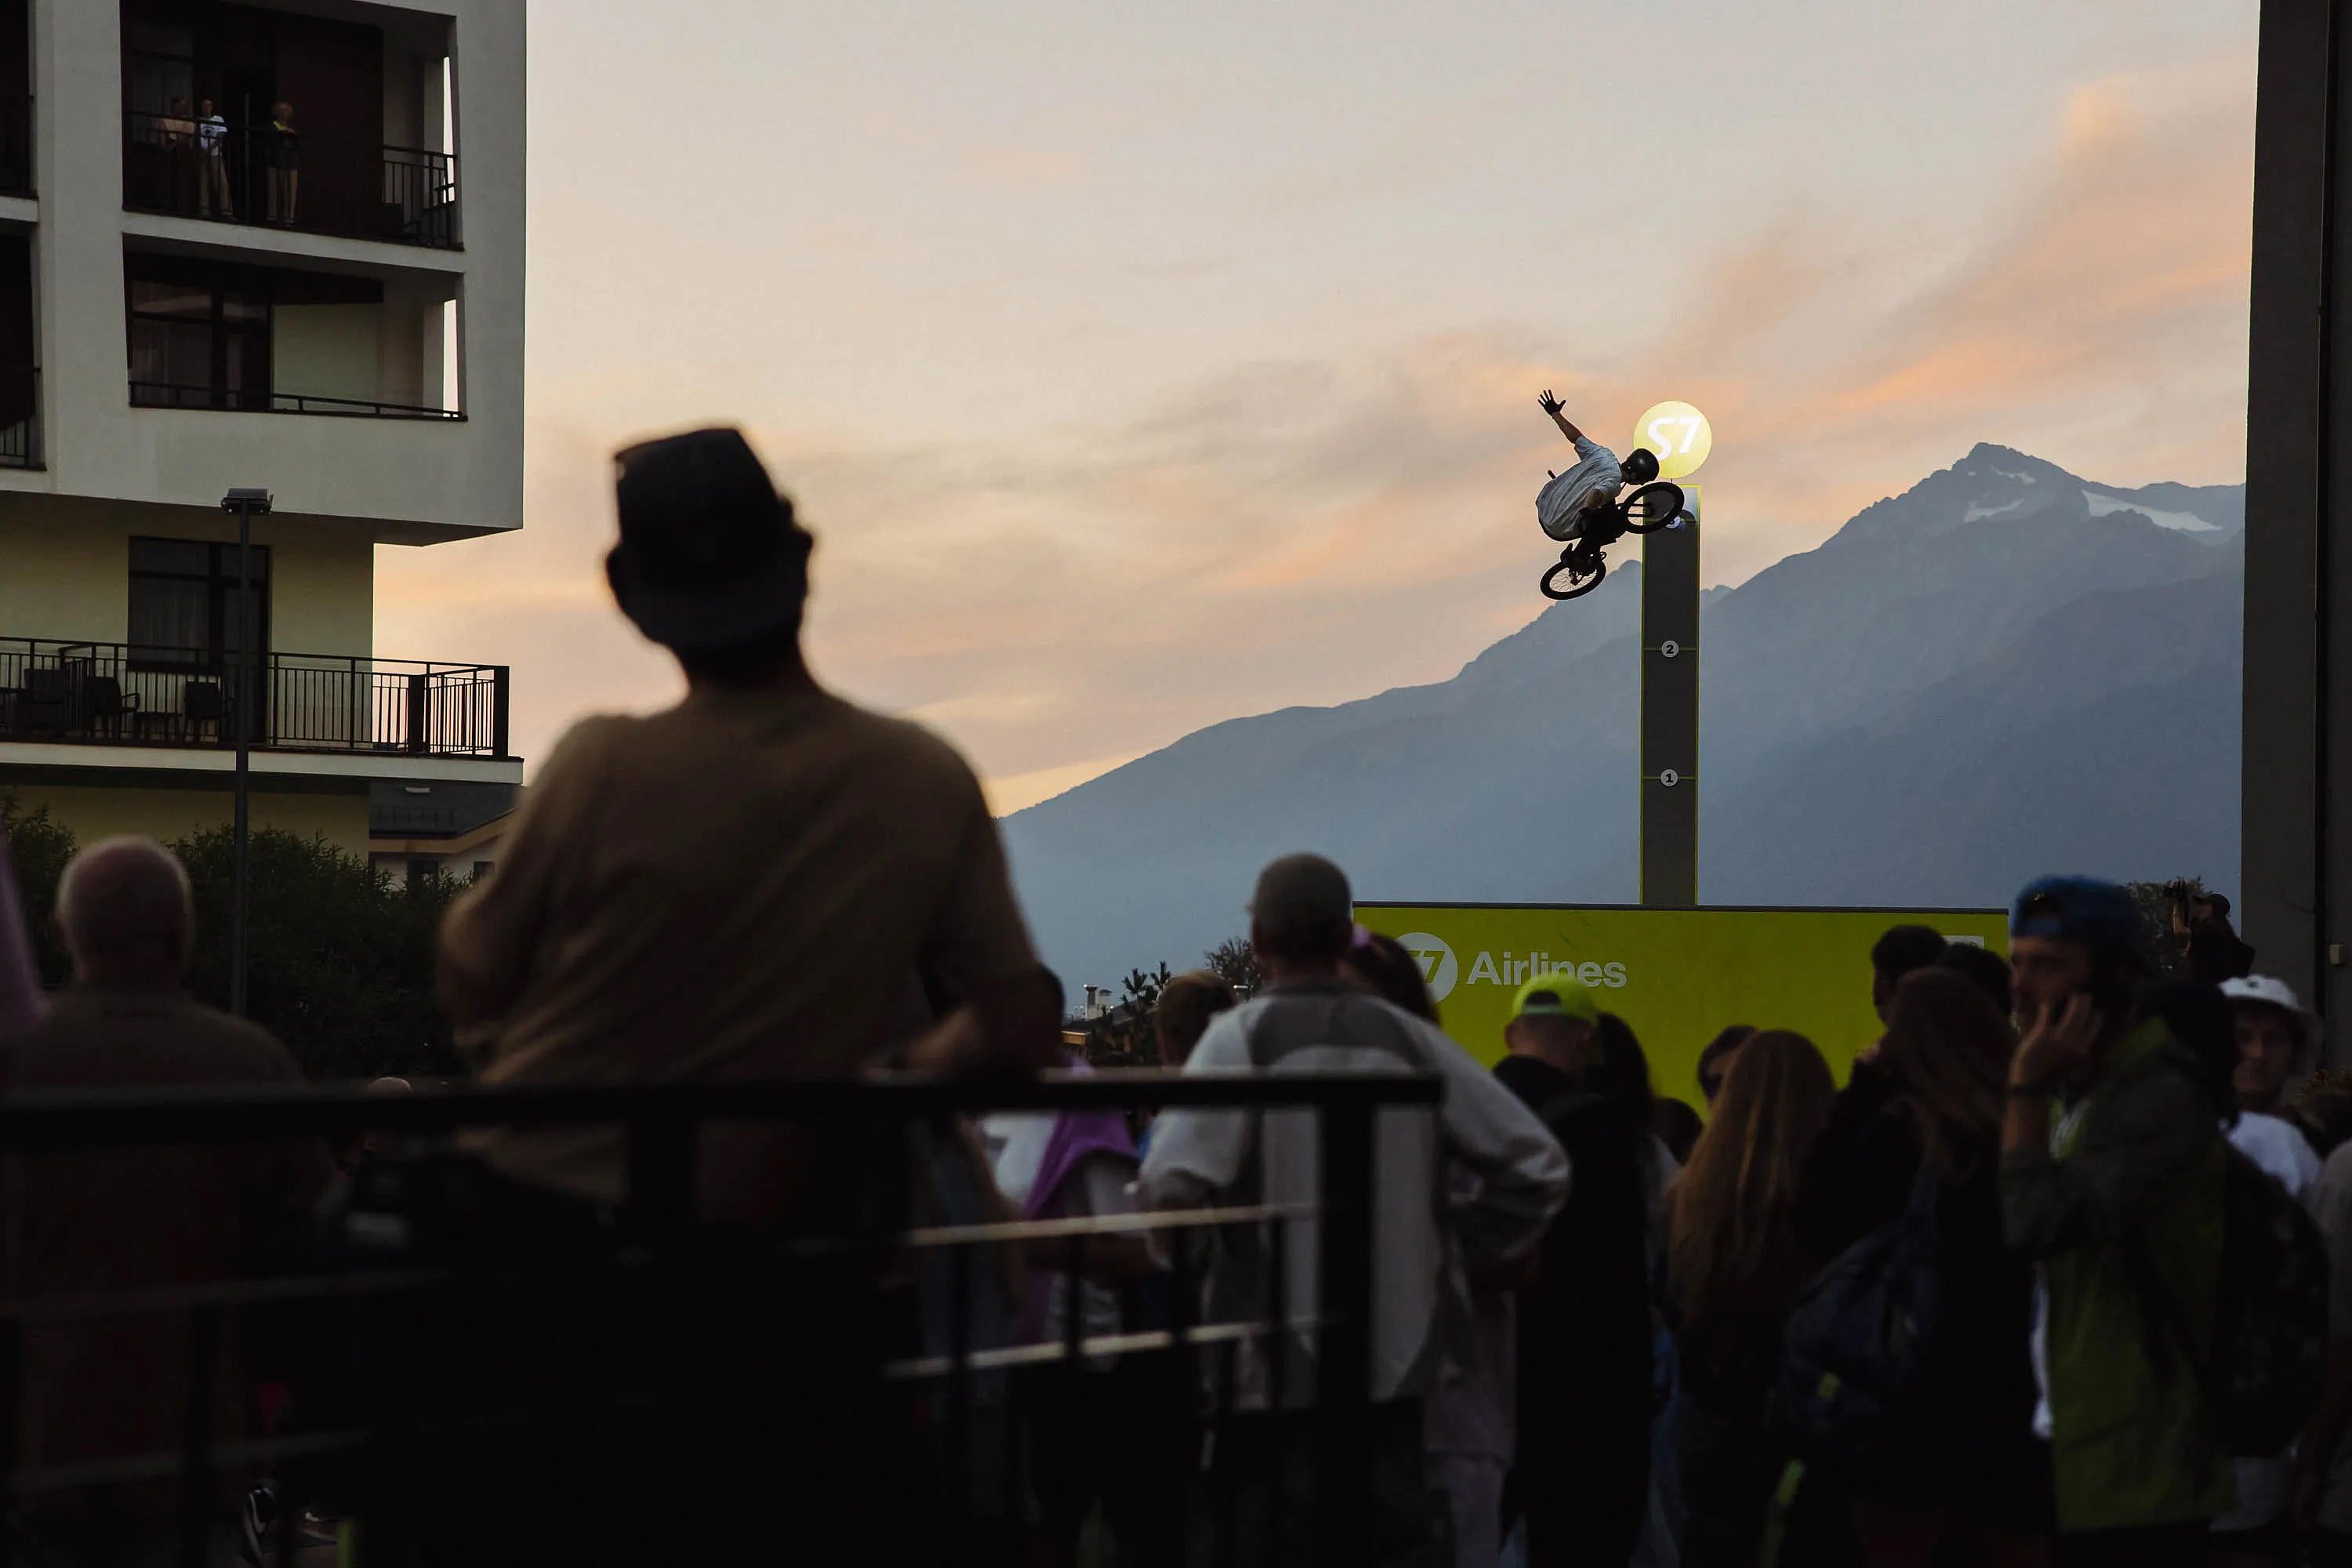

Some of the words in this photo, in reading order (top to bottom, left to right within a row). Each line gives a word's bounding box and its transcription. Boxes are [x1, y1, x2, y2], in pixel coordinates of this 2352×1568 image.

[1647, 416, 1702, 462] S7
[1666, 644, 1675, 655] 2
[1665, 773, 1674, 783] 1
[1404, 949, 1446, 984] 7
[1465, 951, 1628, 988] Airlines
